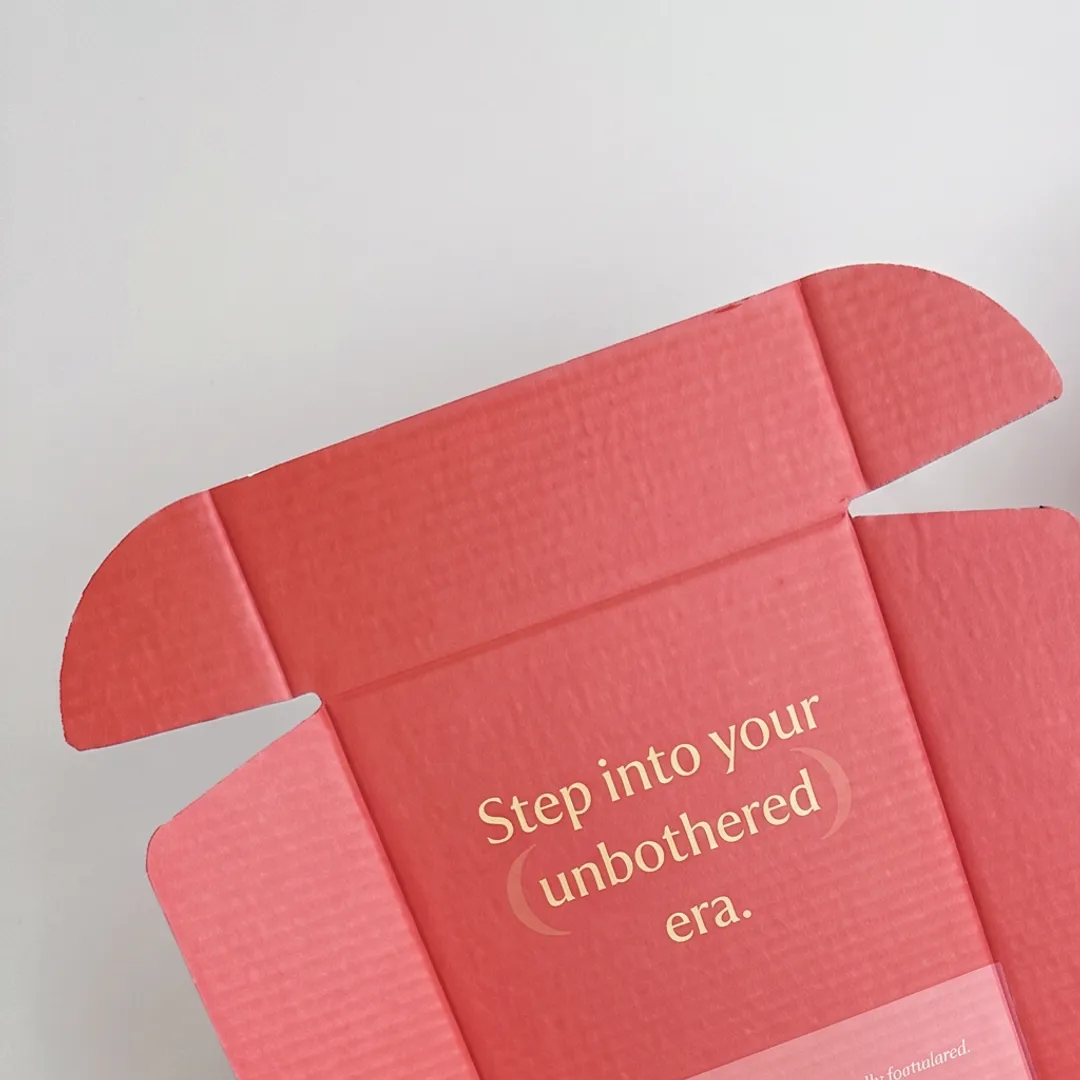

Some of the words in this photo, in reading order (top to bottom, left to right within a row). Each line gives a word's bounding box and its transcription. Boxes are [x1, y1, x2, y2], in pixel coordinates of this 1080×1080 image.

[478, 780, 592, 845] Step
[598, 743, 701, 802] into
[708, 694, 819, 774] your
[665, 895, 752, 942] era.
